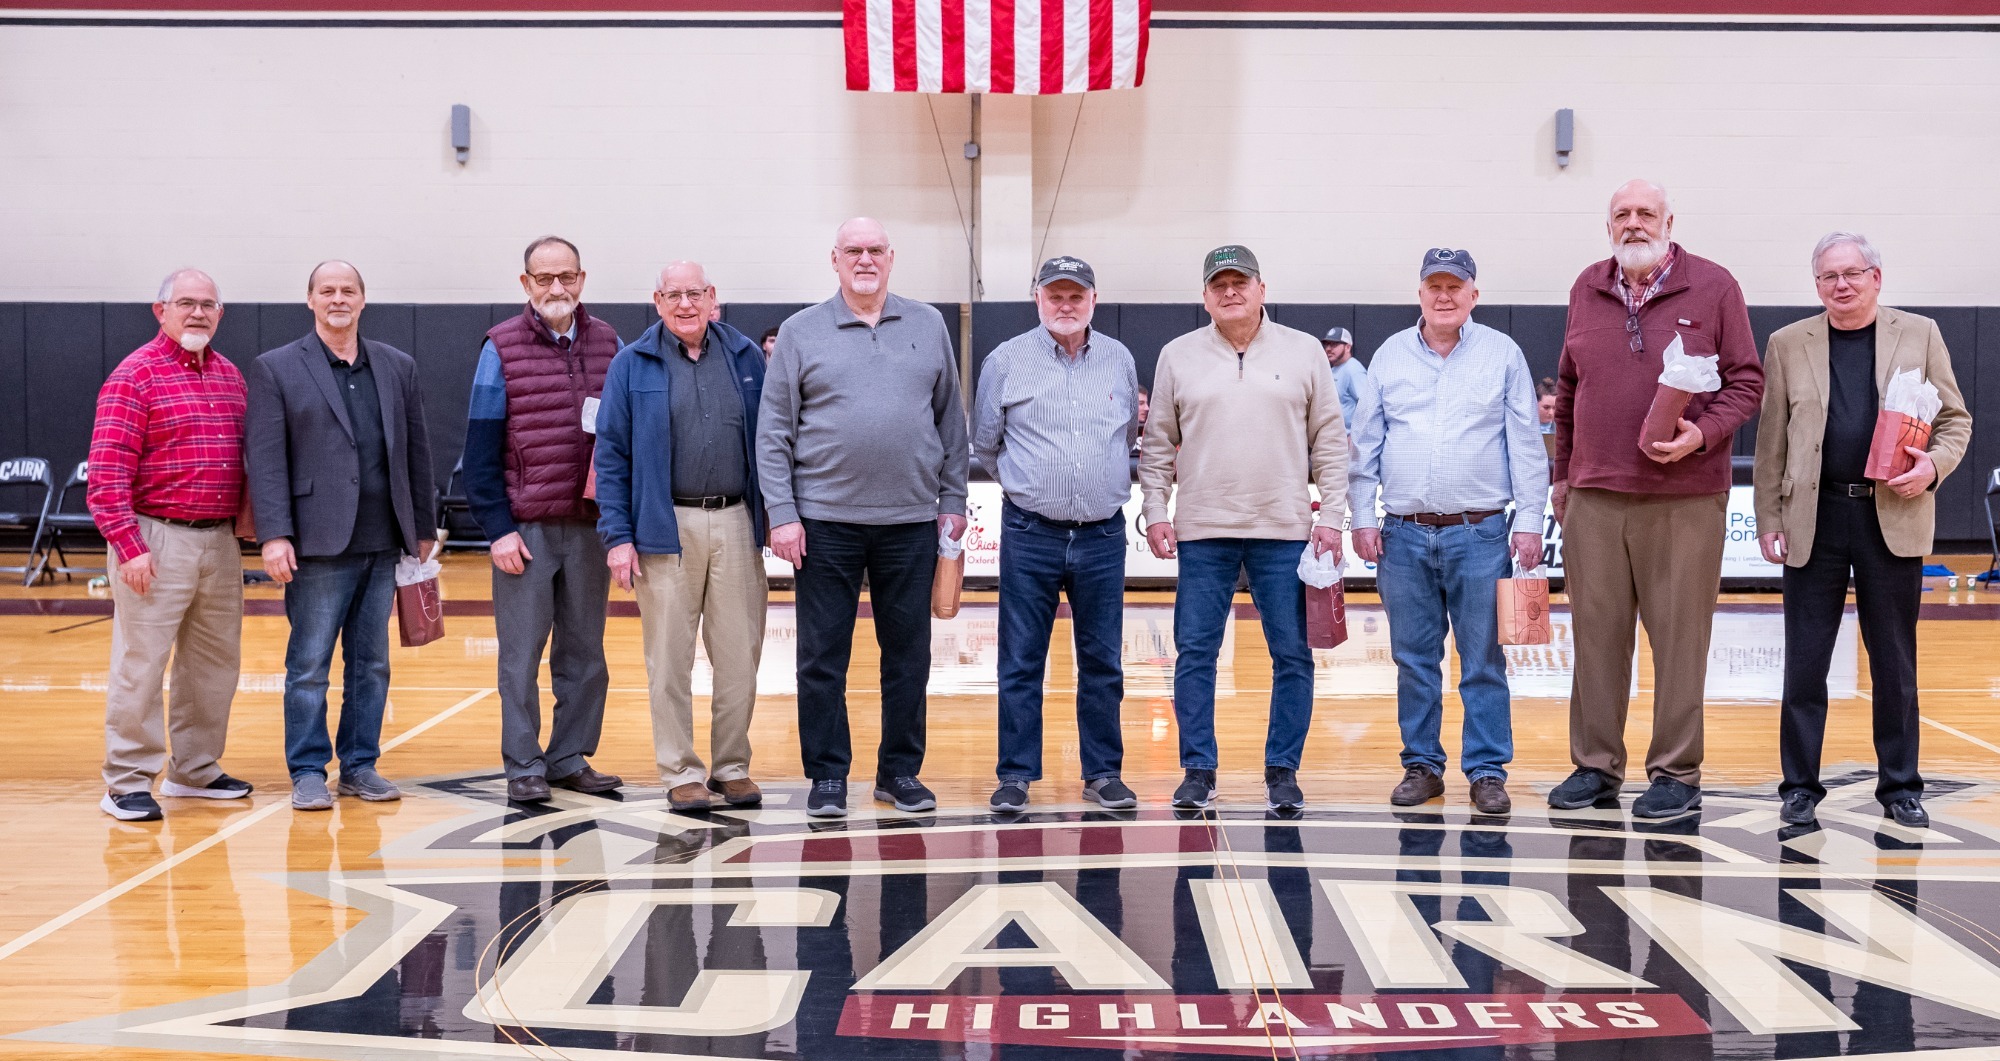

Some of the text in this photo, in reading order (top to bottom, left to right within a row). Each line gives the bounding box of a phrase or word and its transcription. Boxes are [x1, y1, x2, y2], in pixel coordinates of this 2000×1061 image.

[1215, 258, 1238, 266] THING
[0, 461, 46, 481] CAIRN
[967, 556, 995, 564] Oxford
[462, 880, 2000, 1036] CAIRN
[890, 1002, 1664, 1030] HIGHLANDERS
